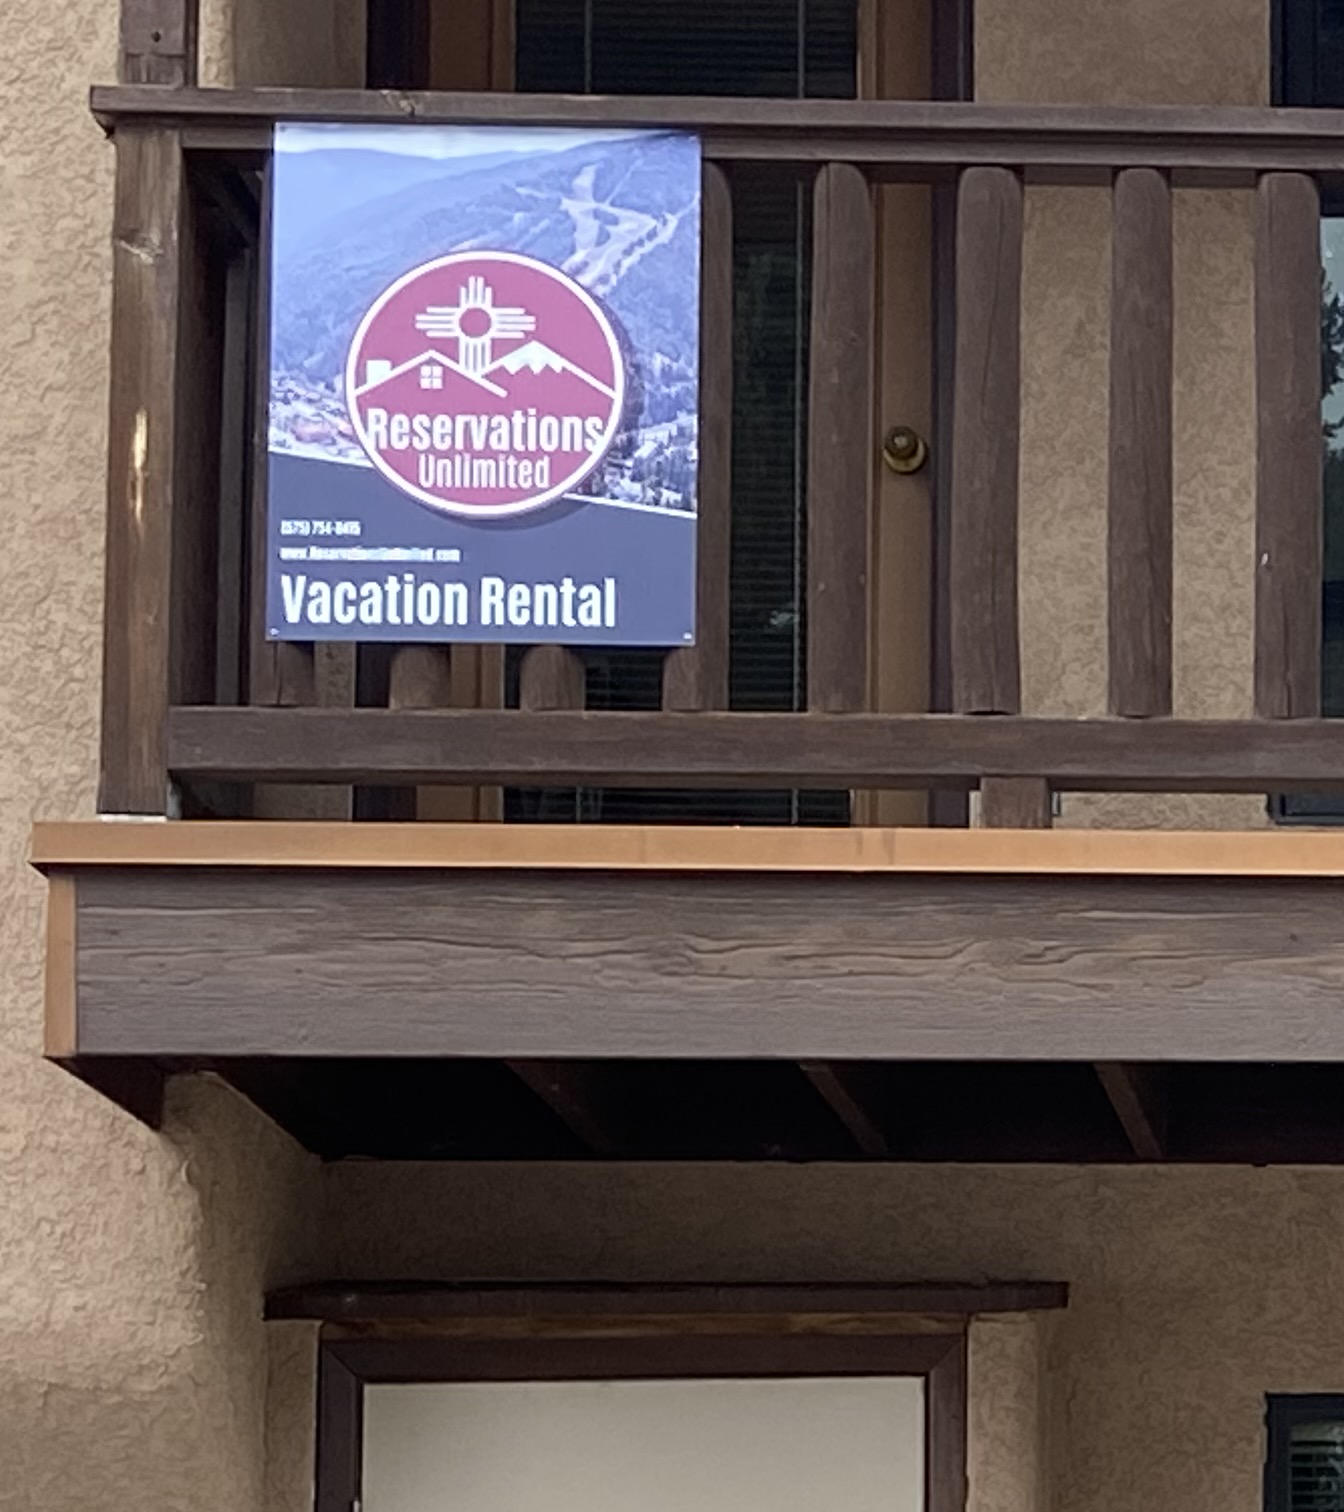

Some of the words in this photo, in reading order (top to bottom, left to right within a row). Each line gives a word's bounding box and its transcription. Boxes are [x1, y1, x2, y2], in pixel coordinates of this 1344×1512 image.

[366, 407, 606, 452] Reservations
[417, 452, 551, 489] Unlimited
[280, 572, 468, 625] Vacation
[480, 576, 616, 627] Rental
